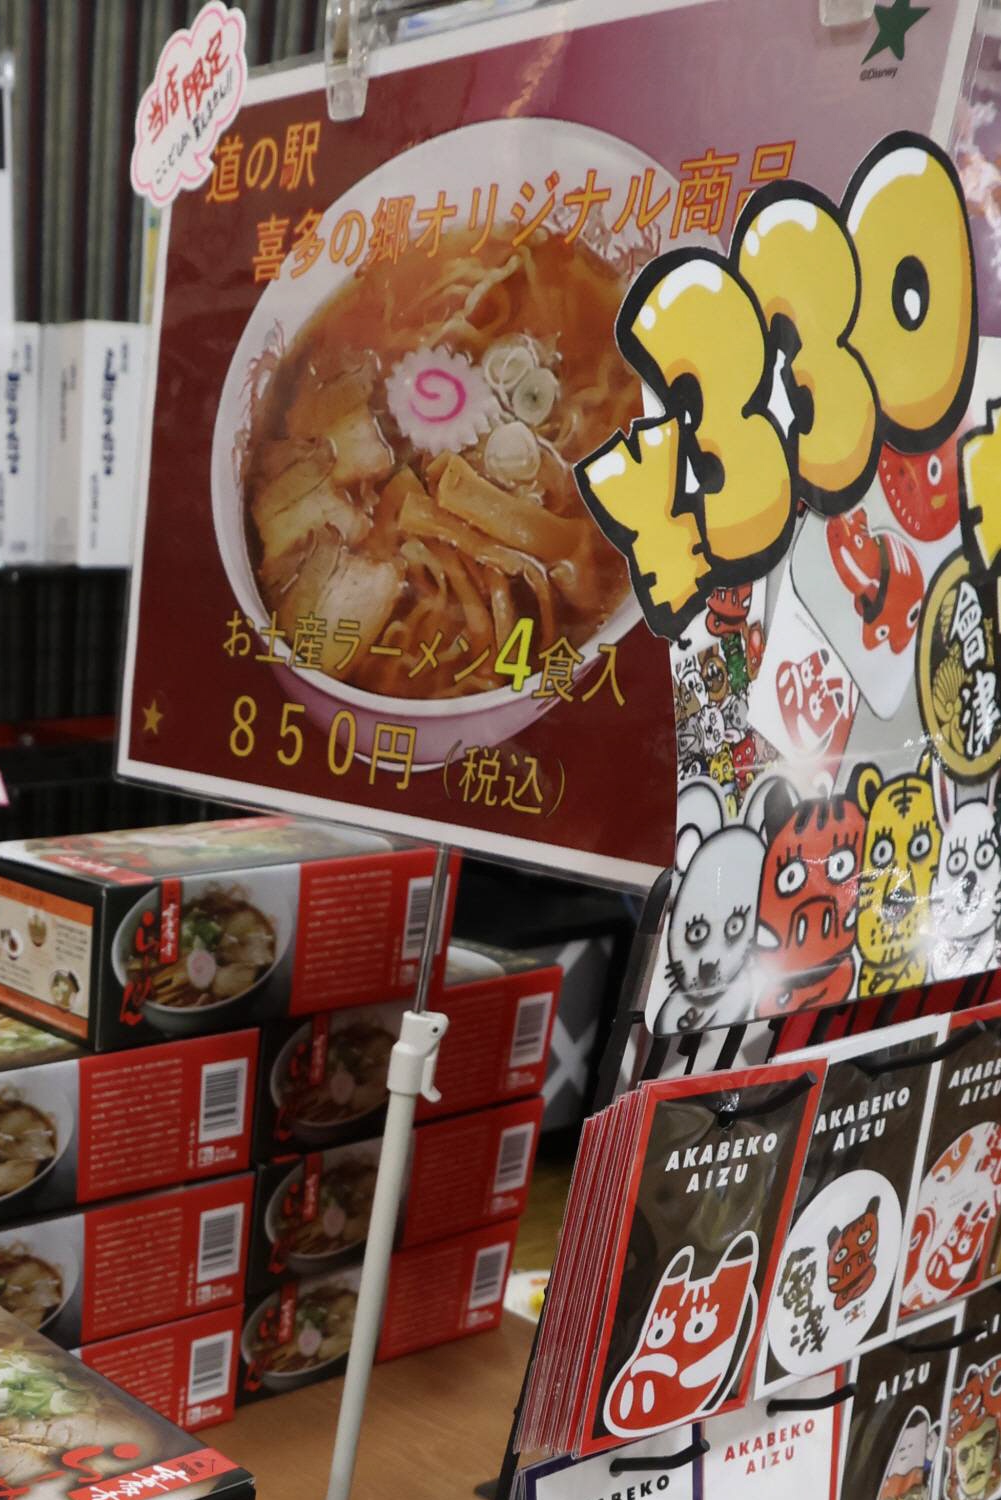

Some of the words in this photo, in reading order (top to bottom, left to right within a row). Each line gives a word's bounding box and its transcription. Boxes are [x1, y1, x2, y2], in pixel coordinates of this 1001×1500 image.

[205, 121, 321, 204] 道の駅
[815, 1086, 911, 1135] AKABEKO
[665, 1132, 778, 1172] AKABEKO
[832, 1121, 887, 1153] AIZU
[686, 1168, 749, 1194] AIZU
[875, 1360, 932, 1403] AIZU
[724, 1418, 816, 1463] AKABEKO
[745, 1445, 795, 1476] AIZU
[89, 1466, 189, 1500] 喜多方
